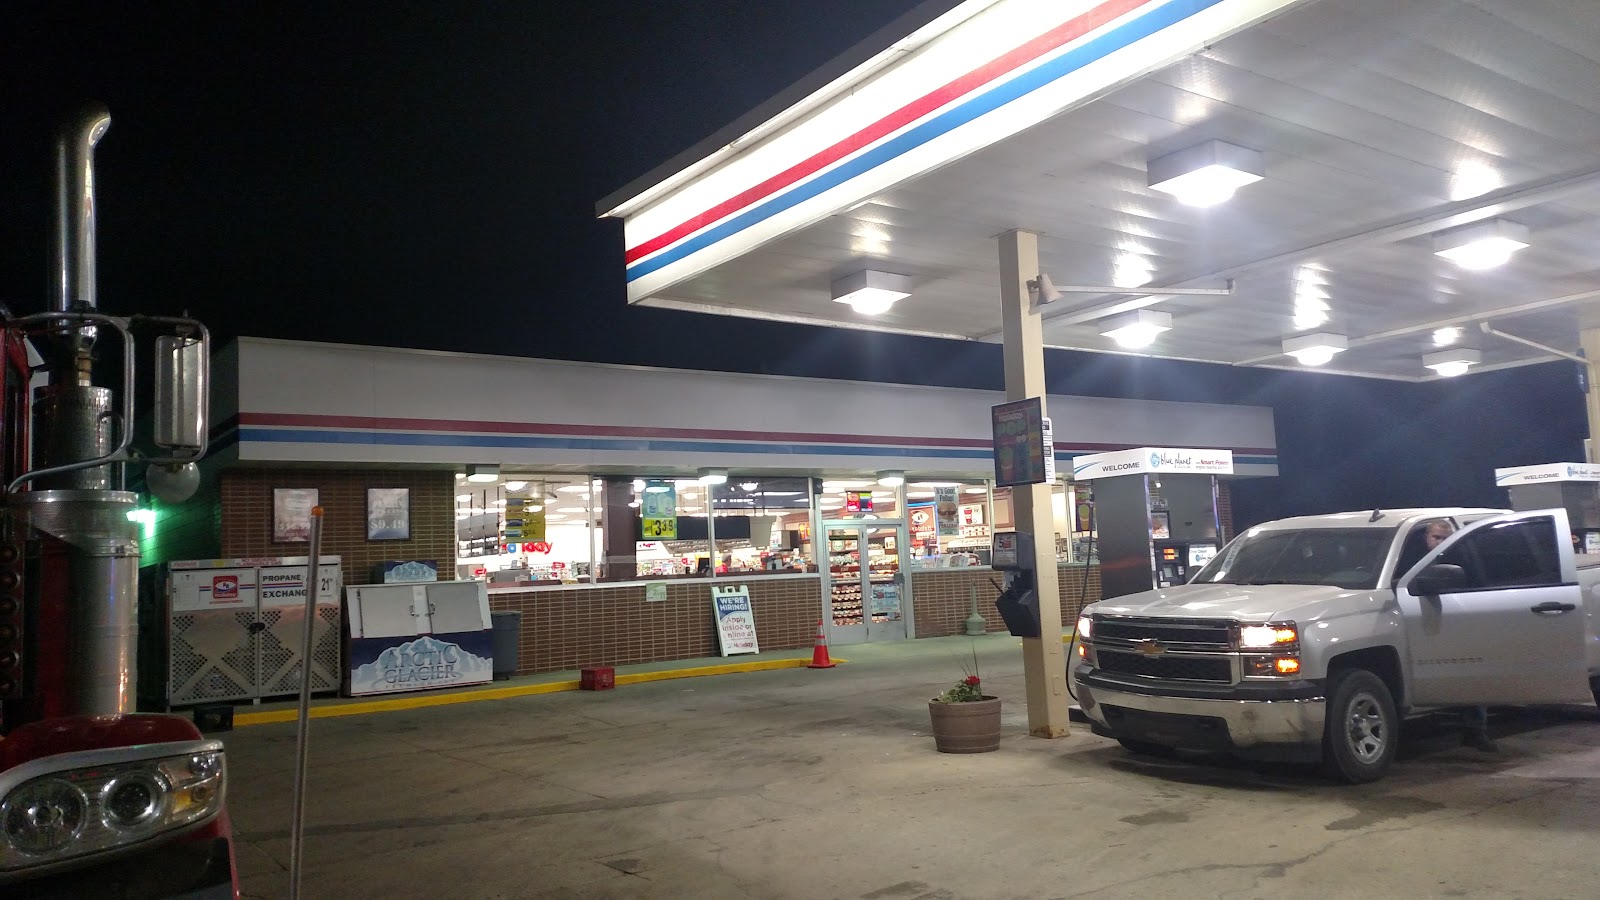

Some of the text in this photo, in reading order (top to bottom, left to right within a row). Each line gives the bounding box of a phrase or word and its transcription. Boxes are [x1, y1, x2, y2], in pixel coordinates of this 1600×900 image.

[1160, 452, 1192, 467] blue planet
[1102, 461, 1140, 472] WELCOME
[1524, 472, 1560, 480] WELCOME
[371, 519, 405, 530] $9.49
[262, 574, 301, 582] PROPANE
[262, 589, 307, 599] EXCHANG
[720, 596, 745, 604] WE'RE
[719, 603, 747, 611] HIRING!
[384, 645, 457, 669] ARCTIC
[384, 664, 457, 683] GLACIER
